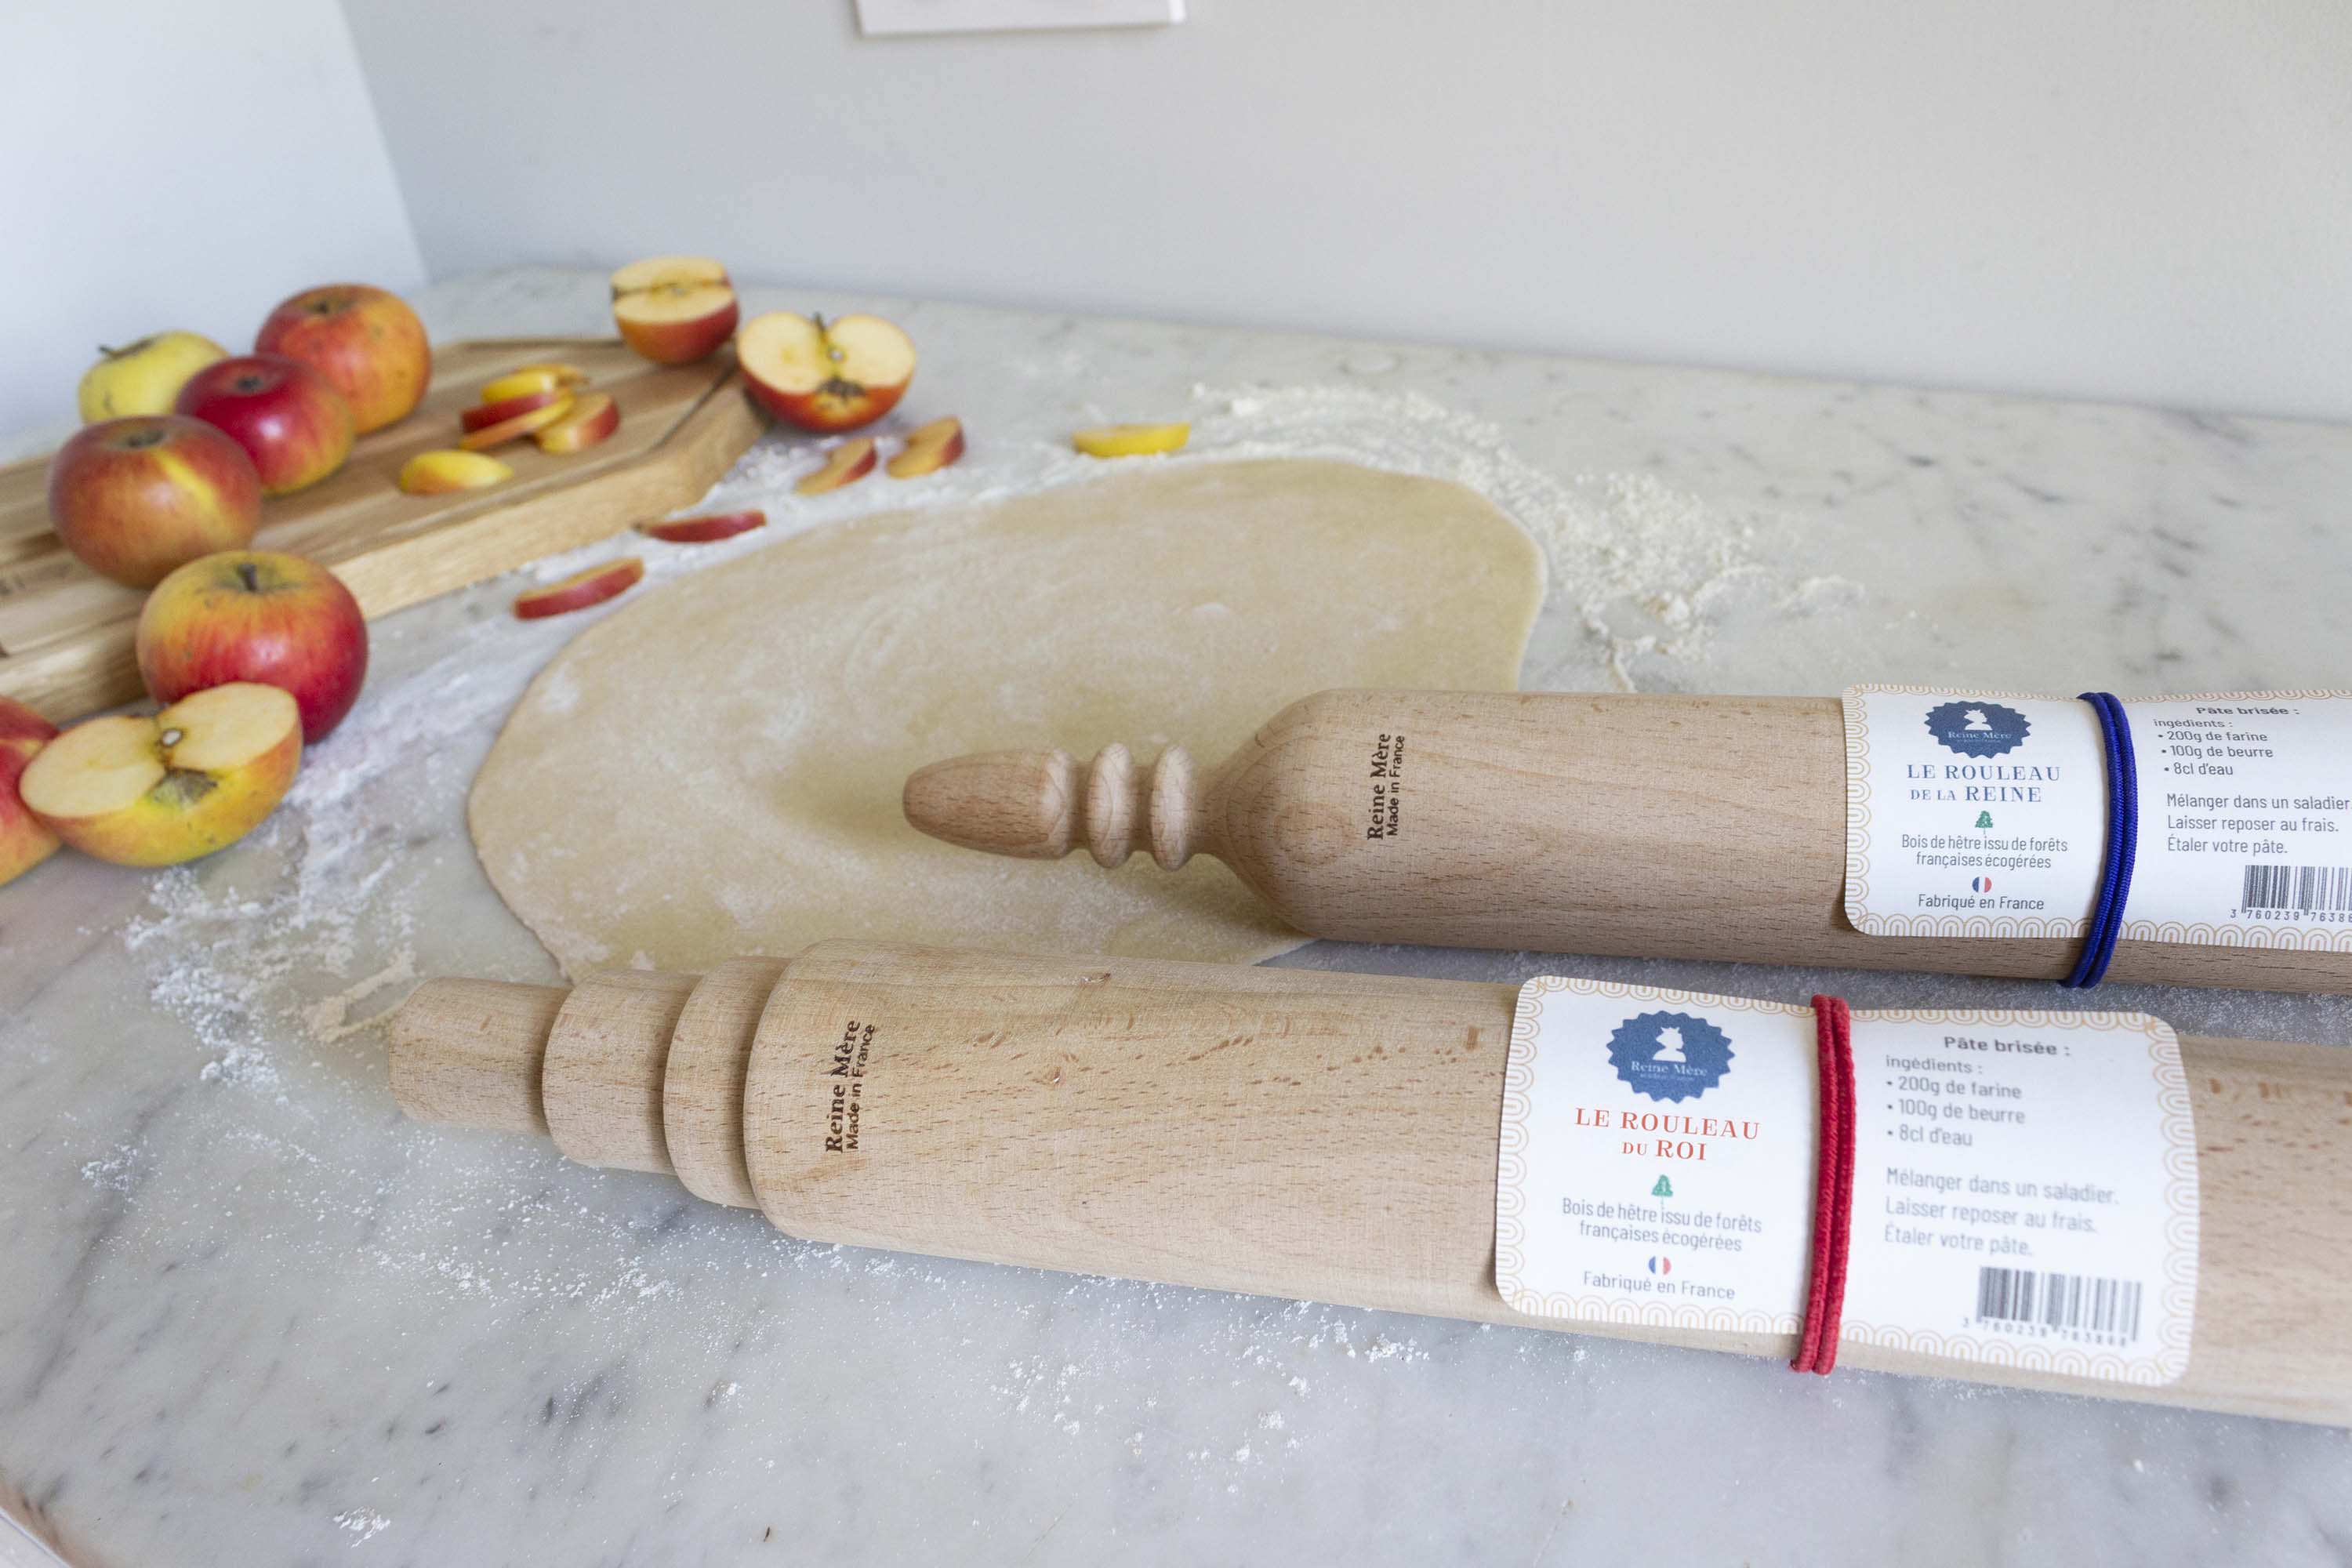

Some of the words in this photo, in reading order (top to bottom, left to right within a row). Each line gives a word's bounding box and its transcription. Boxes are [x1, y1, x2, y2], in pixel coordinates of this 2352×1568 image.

[2154, 719, 2225, 728] ingédients
[2167, 731, 2201, 742] 200g
[2205, 732, 2222, 741] de
[2226, 732, 2267, 742] farine
[1370, 734, 1391, 778] Mère
[1389, 735, 1405, 777] France
[2169, 746, 2202, 758] 100g
[2207, 746, 2223, 757] de
[2227, 747, 2273, 757] beurre
[1907, 764, 1936, 779] LE
[1945, 765, 2060, 781] ROULEAU
[2173, 763, 2194, 775] 8cl
[2198, 763, 2233, 775] d'eau
[1388, 782, 1399, 793] in
[1911, 789, 1930, 800] DE
[1937, 790, 1956, 801] LA
[1965, 786, 2042, 803] REINE
[1367, 784, 1385, 840] Reine
[2167, 793, 2229, 811] Mélanger
[2234, 795, 2267, 808] dans
[2272, 798, 2288, 809] un
[1387, 797, 1399, 836] Made
[2168, 815, 2218, 830] Laisser
[2221, 818, 2275, 833] reposer
[2280, 820, 2297, 831] au
[2302, 818, 2339, 832] frais.
[1902, 835, 1928, 848] Bois
[1930, 836, 1946, 849] de
[1948, 836, 1982, 850] hêtre
[1984, 837, 2009, 851] issu
[2012, 837, 2027, 851] de
[2029, 837, 2067, 851] forêts
[2168, 834, 2208, 852] Étaler
[2212, 839, 2248, 853] votre
[2253, 839, 2288, 856] pâte.
[1916, 853, 1983, 868] françaises
[1984, 854, 2051, 870] écogérées
[1918, 894, 1975, 911] Fabriqué
[1979, 898, 1994, 909] en
[1999, 895, 2044, 910] France
[831, 1020, 861, 1077] Mère
[851, 1024, 875, 1077] France
[1944, 1036, 1988, 1052] Pâte
[1994, 1039, 2057, 1055] brisée
[1632, 1061, 1668, 1073] Reine
[1675, 1064, 1708, 1076] Mère
[1886, 1055, 1973, 1074] ingédients
[848, 1083, 862, 1097] in
[1898, 1077, 1940, 1096] 200g
[1945, 1080, 1965, 1095] de
[1970, 1082, 2022, 1098] farine
[826, 1084, 846, 1153] Reine
[1898, 1099, 1936, 1121] 100g
[1943, 1104, 1963, 1120] de
[1969, 1105, 2025, 1123] beurre
[846, 1102, 860, 1149] Made
[1574, 1108, 1610, 1127] LE
[1619, 1111, 1761, 1140] ROULEAU
[1898, 1126, 1924, 1142] 8cl
[1929, 1127, 1973, 1146] d'eau
[1622, 1142, 1647, 1156] DU
[1655, 1139, 1708, 1161] ROI
[1886, 1167, 1962, 1193] Mélanger
[1969, 1174, 2010, 1195] dans
[2016, 1183, 2038, 1198] un
[2043, 1181, 2119, 1204] saladier.
[1563, 1198, 1594, 1217] Bois
[1597, 1202, 1615, 1218] de
[1618, 1203, 1657, 1223] hêtre
[1661, 1206, 1691, 1225] issu
[1693, 1210, 1712, 1227] de
[1716, 1211, 1762, 1233] forêts
[1886, 1196, 1946, 1219] Laisser
[1952, 1206, 2019, 1227] reposer
[2025, 1213, 2046, 1229] au
[2052, 1213, 2097, 1232] frais.
[1579, 1221, 1659, 1243] françaises
[1662, 1229, 1742, 1252] écogérées
[1885, 1224, 1934, 1246] Étaler
[1940, 1235, 1984, 1251] votre
[1990, 1236, 2032, 1257] pâte.
[1583, 1272, 1652, 1294] Fabriqué
[1657, 1280, 1676, 1294] en
[1681, 1281, 1735, 1300] France
